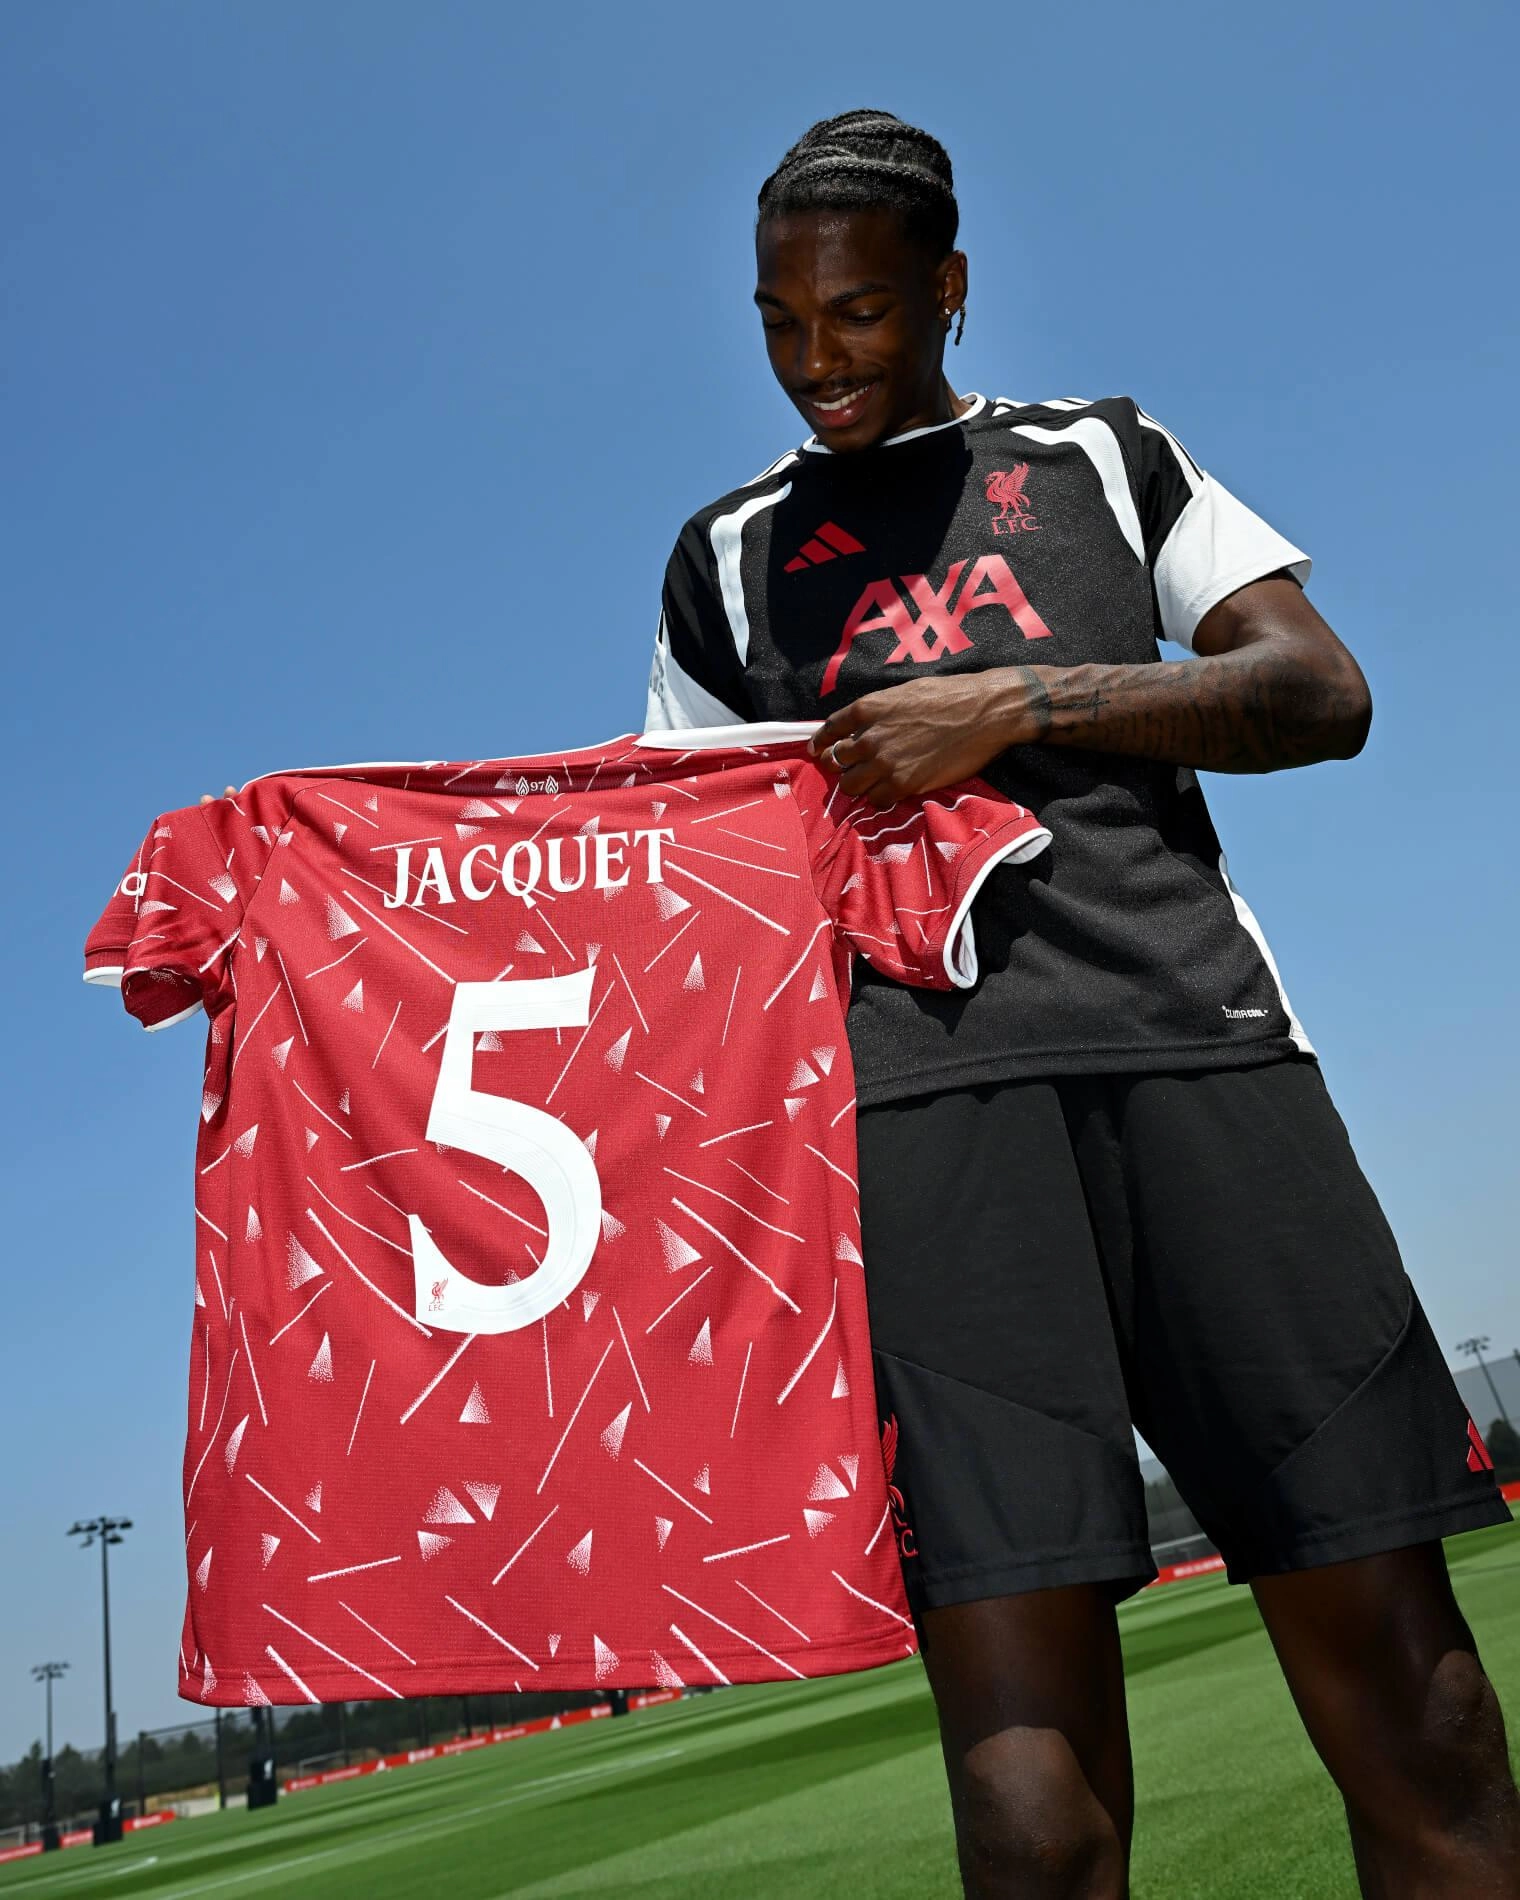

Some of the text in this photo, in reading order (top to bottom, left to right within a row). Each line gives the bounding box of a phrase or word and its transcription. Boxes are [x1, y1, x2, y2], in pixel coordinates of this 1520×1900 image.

[819, 553, 1054, 698] AXA
[530, 781, 545, 792] 97
[383, 827, 676, 910] JACQUET
[408, 964, 602, 1335] 5
